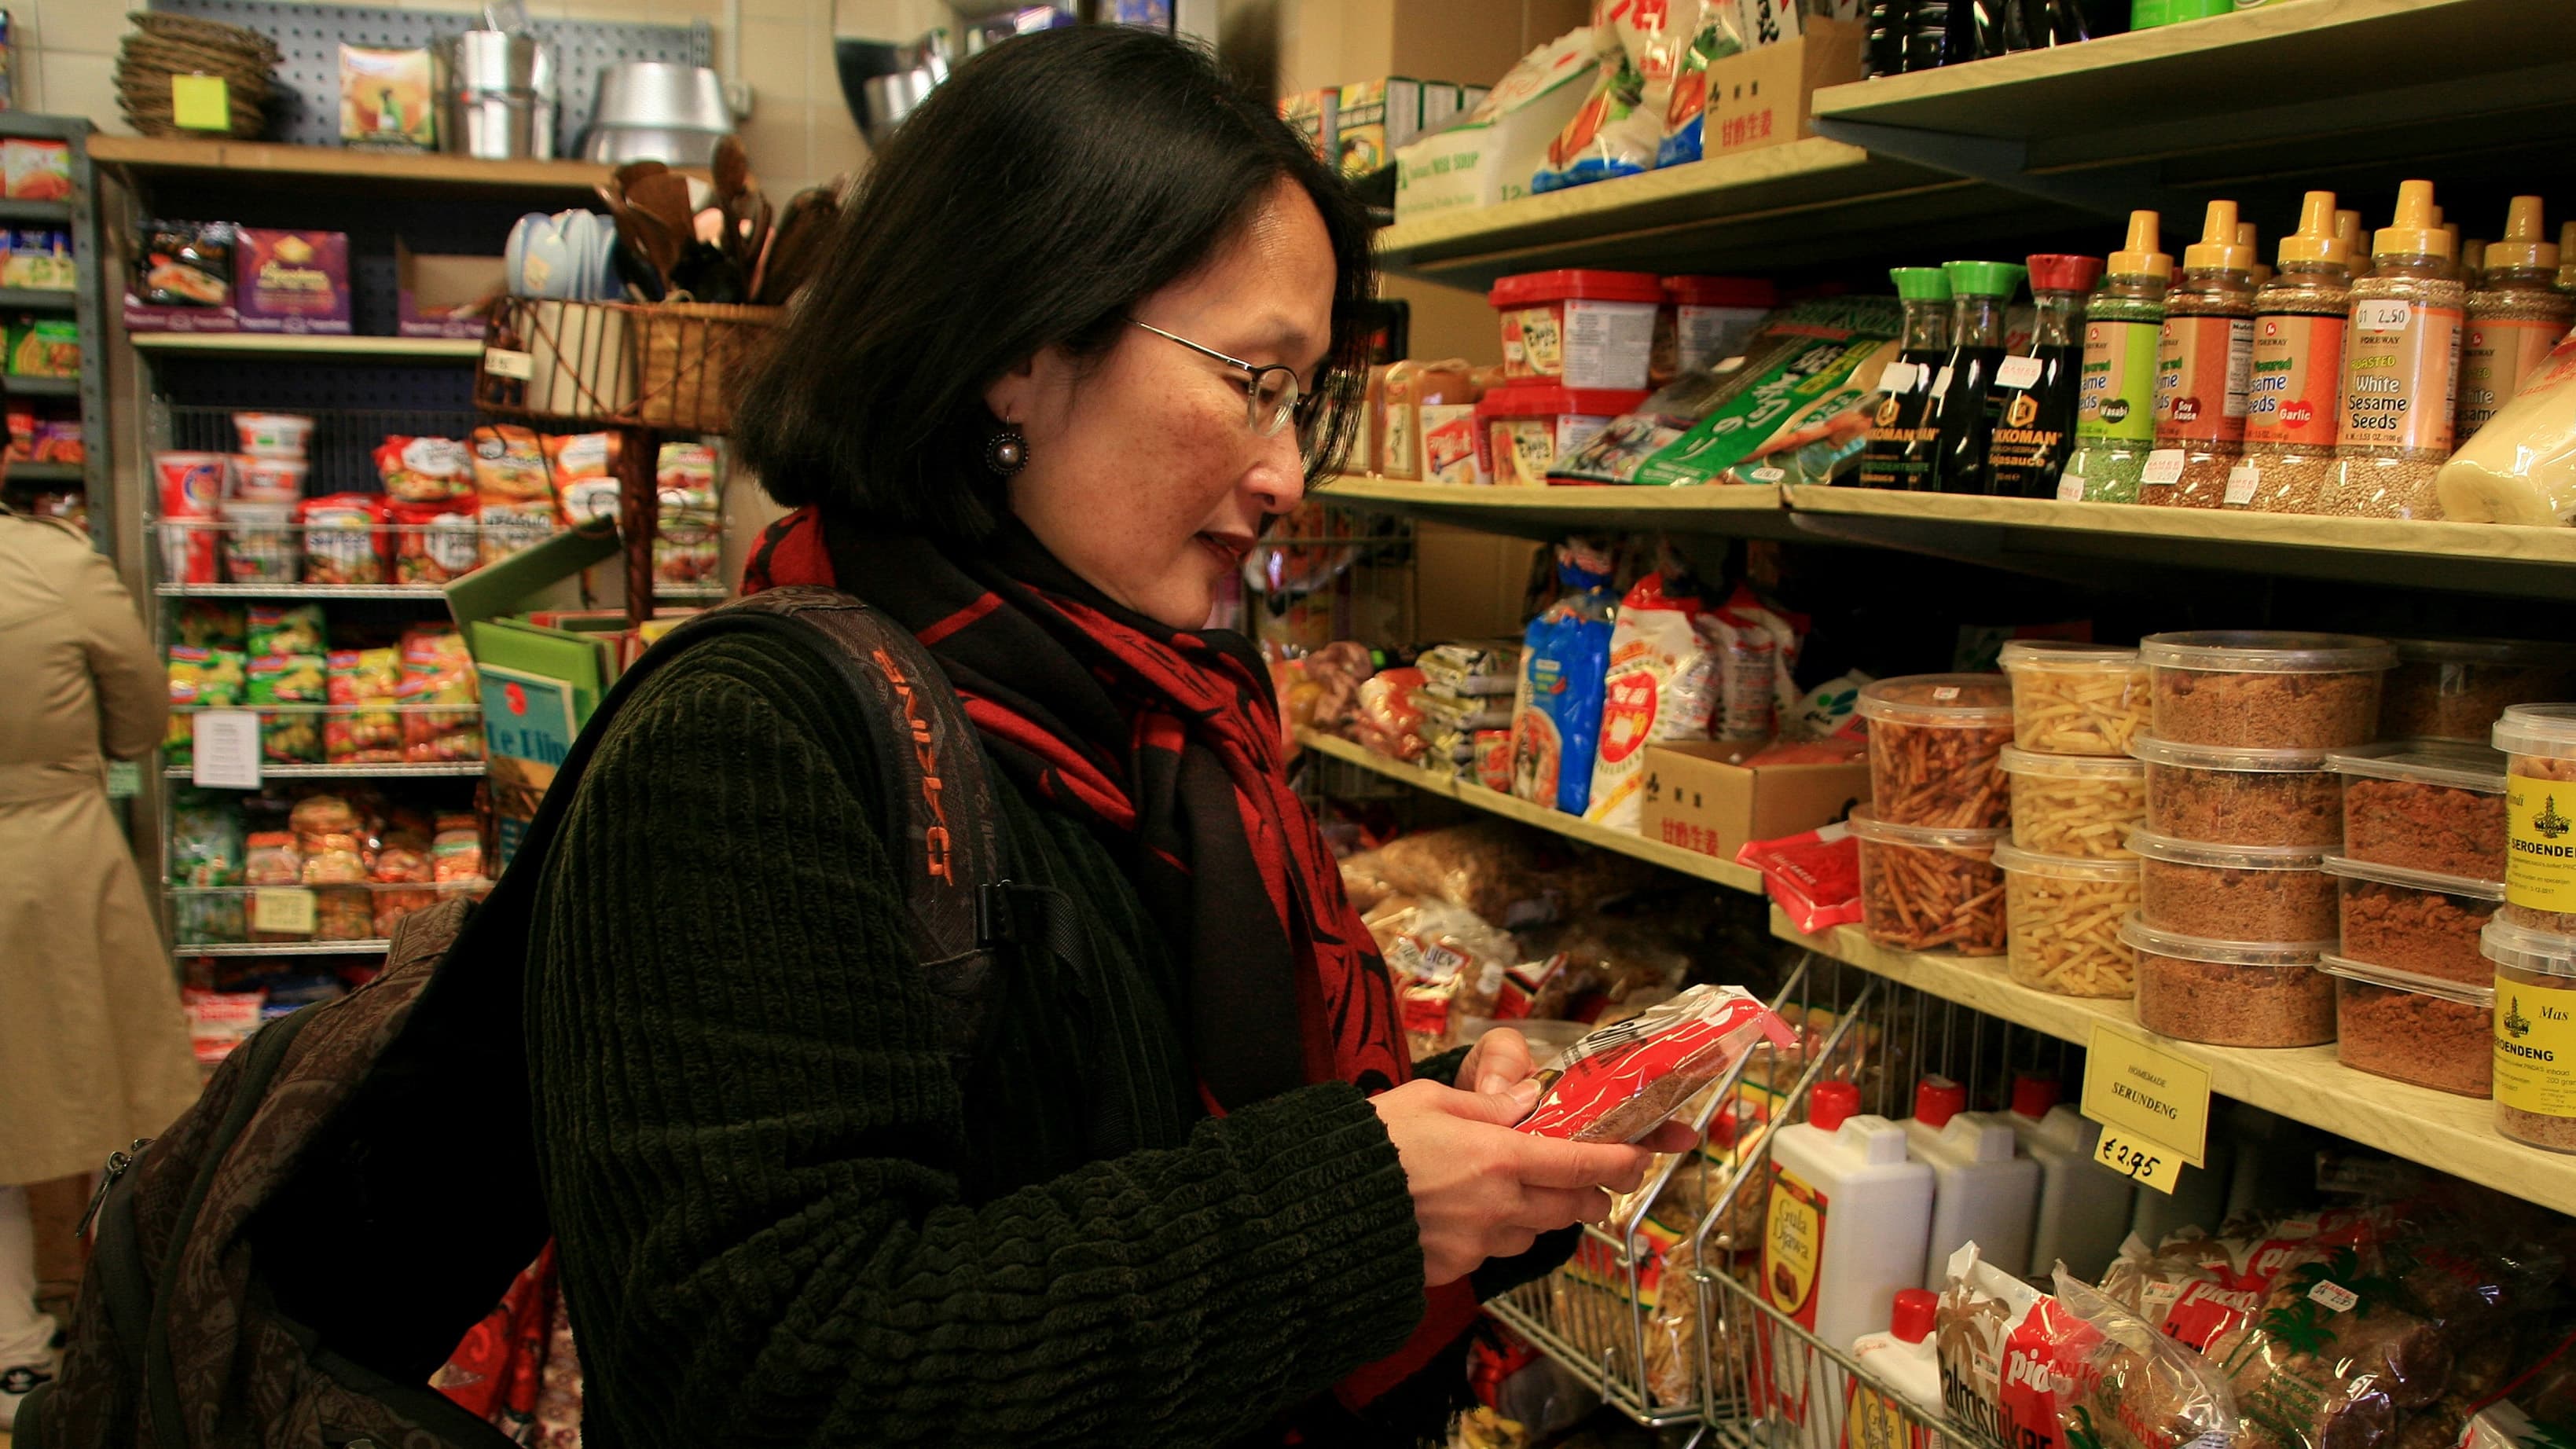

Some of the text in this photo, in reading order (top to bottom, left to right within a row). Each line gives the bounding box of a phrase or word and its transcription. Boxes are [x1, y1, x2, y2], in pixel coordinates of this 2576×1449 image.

[2378, 310, 2405, 324] 2.50
[2361, 336, 2401, 345] FOREWAY
[2356, 375, 2400, 393] White
[2349, 395, 2407, 411] Sesame
[2280, 408, 2312, 422] Garlic
[2352, 413, 2398, 429] Seeds
[1993, 427, 2059, 446] KKOMAN
[2511, 837, 2576, 859] SEROENDE
[2539, 1005, 2569, 1022] Mas
[2127, 1064, 2167, 1088] HOMEMADE
[2546, 1067, 2570, 1077] inhoud
[2112, 1081, 2178, 1120] SERUNDENG
[1779, 1198, 1807, 1235] Gula
